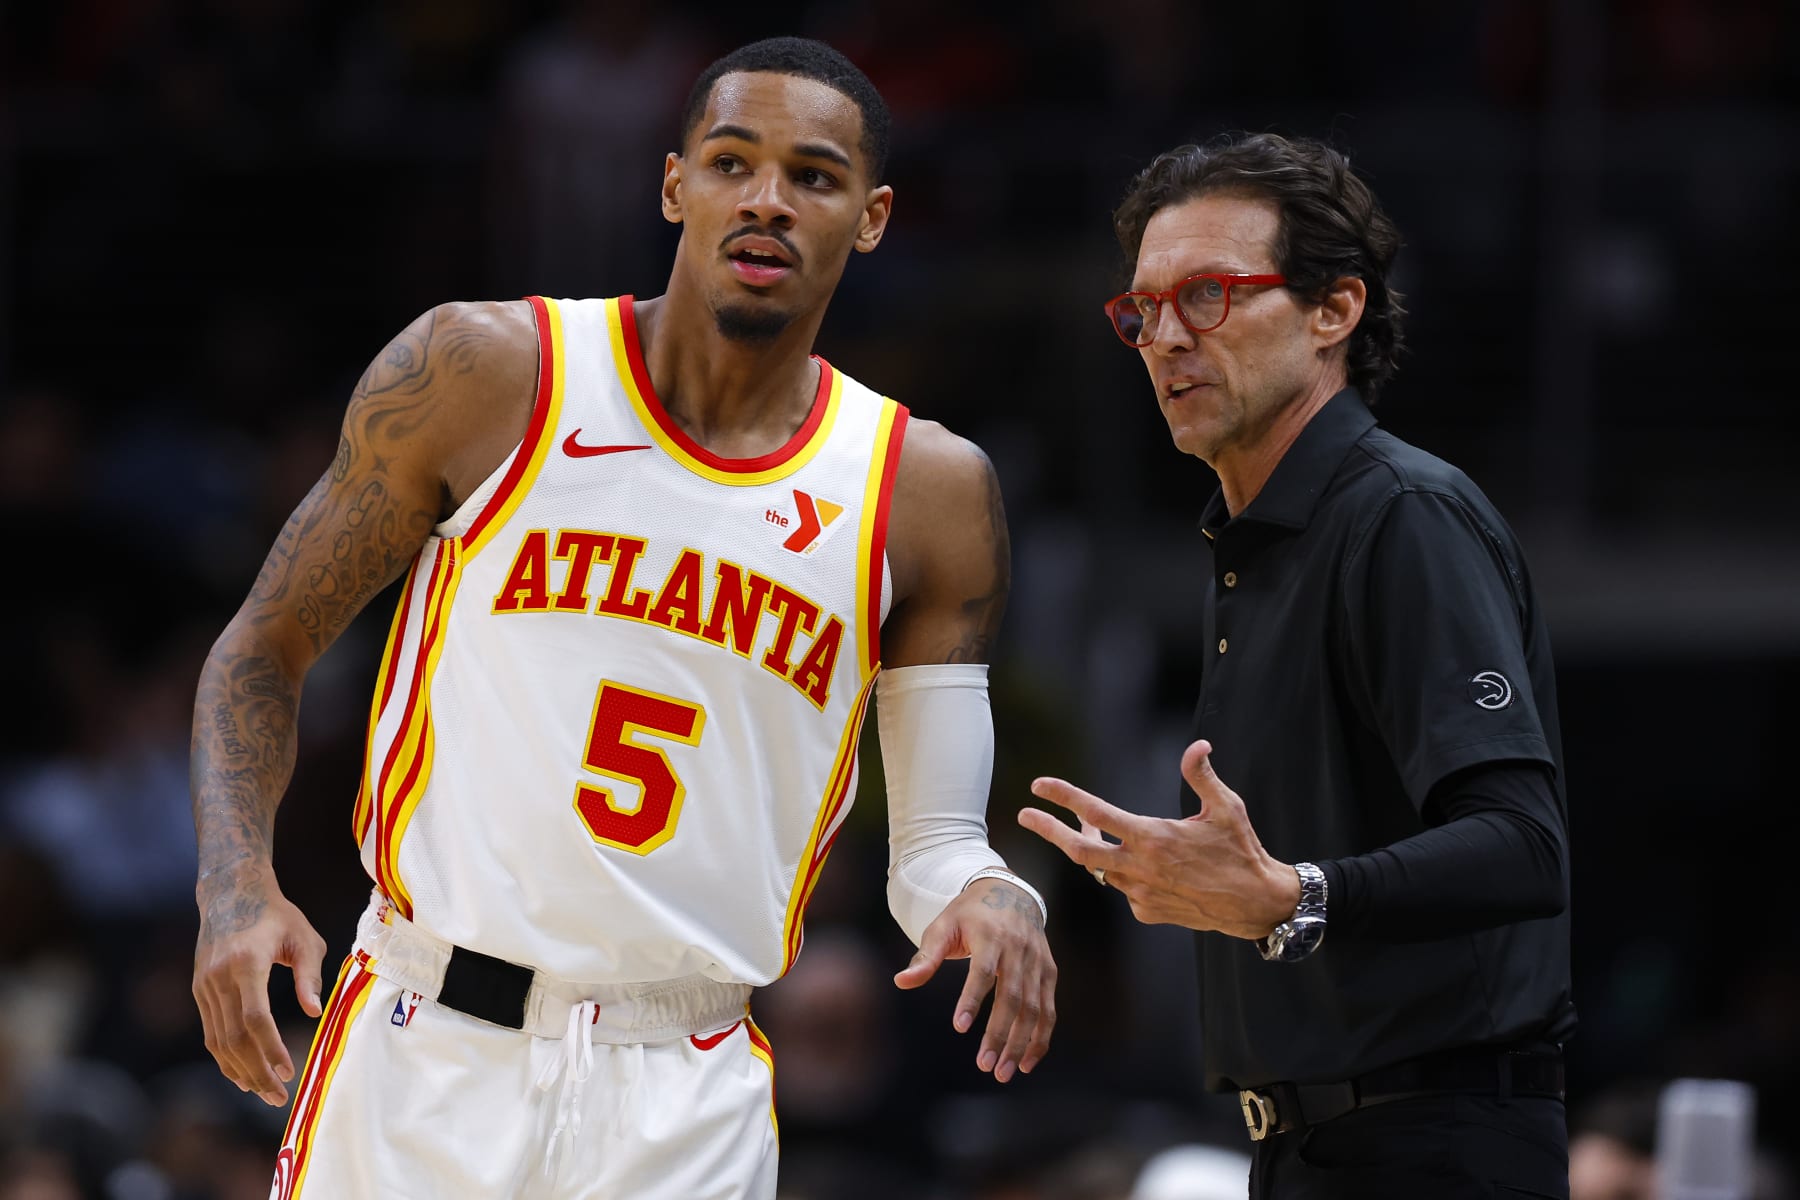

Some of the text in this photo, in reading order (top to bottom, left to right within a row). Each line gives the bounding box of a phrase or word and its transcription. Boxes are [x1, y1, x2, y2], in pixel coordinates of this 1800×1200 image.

[765, 509, 789, 528] the
[490, 528, 846, 714] ATLANTA
[572, 678, 708, 857] 5
